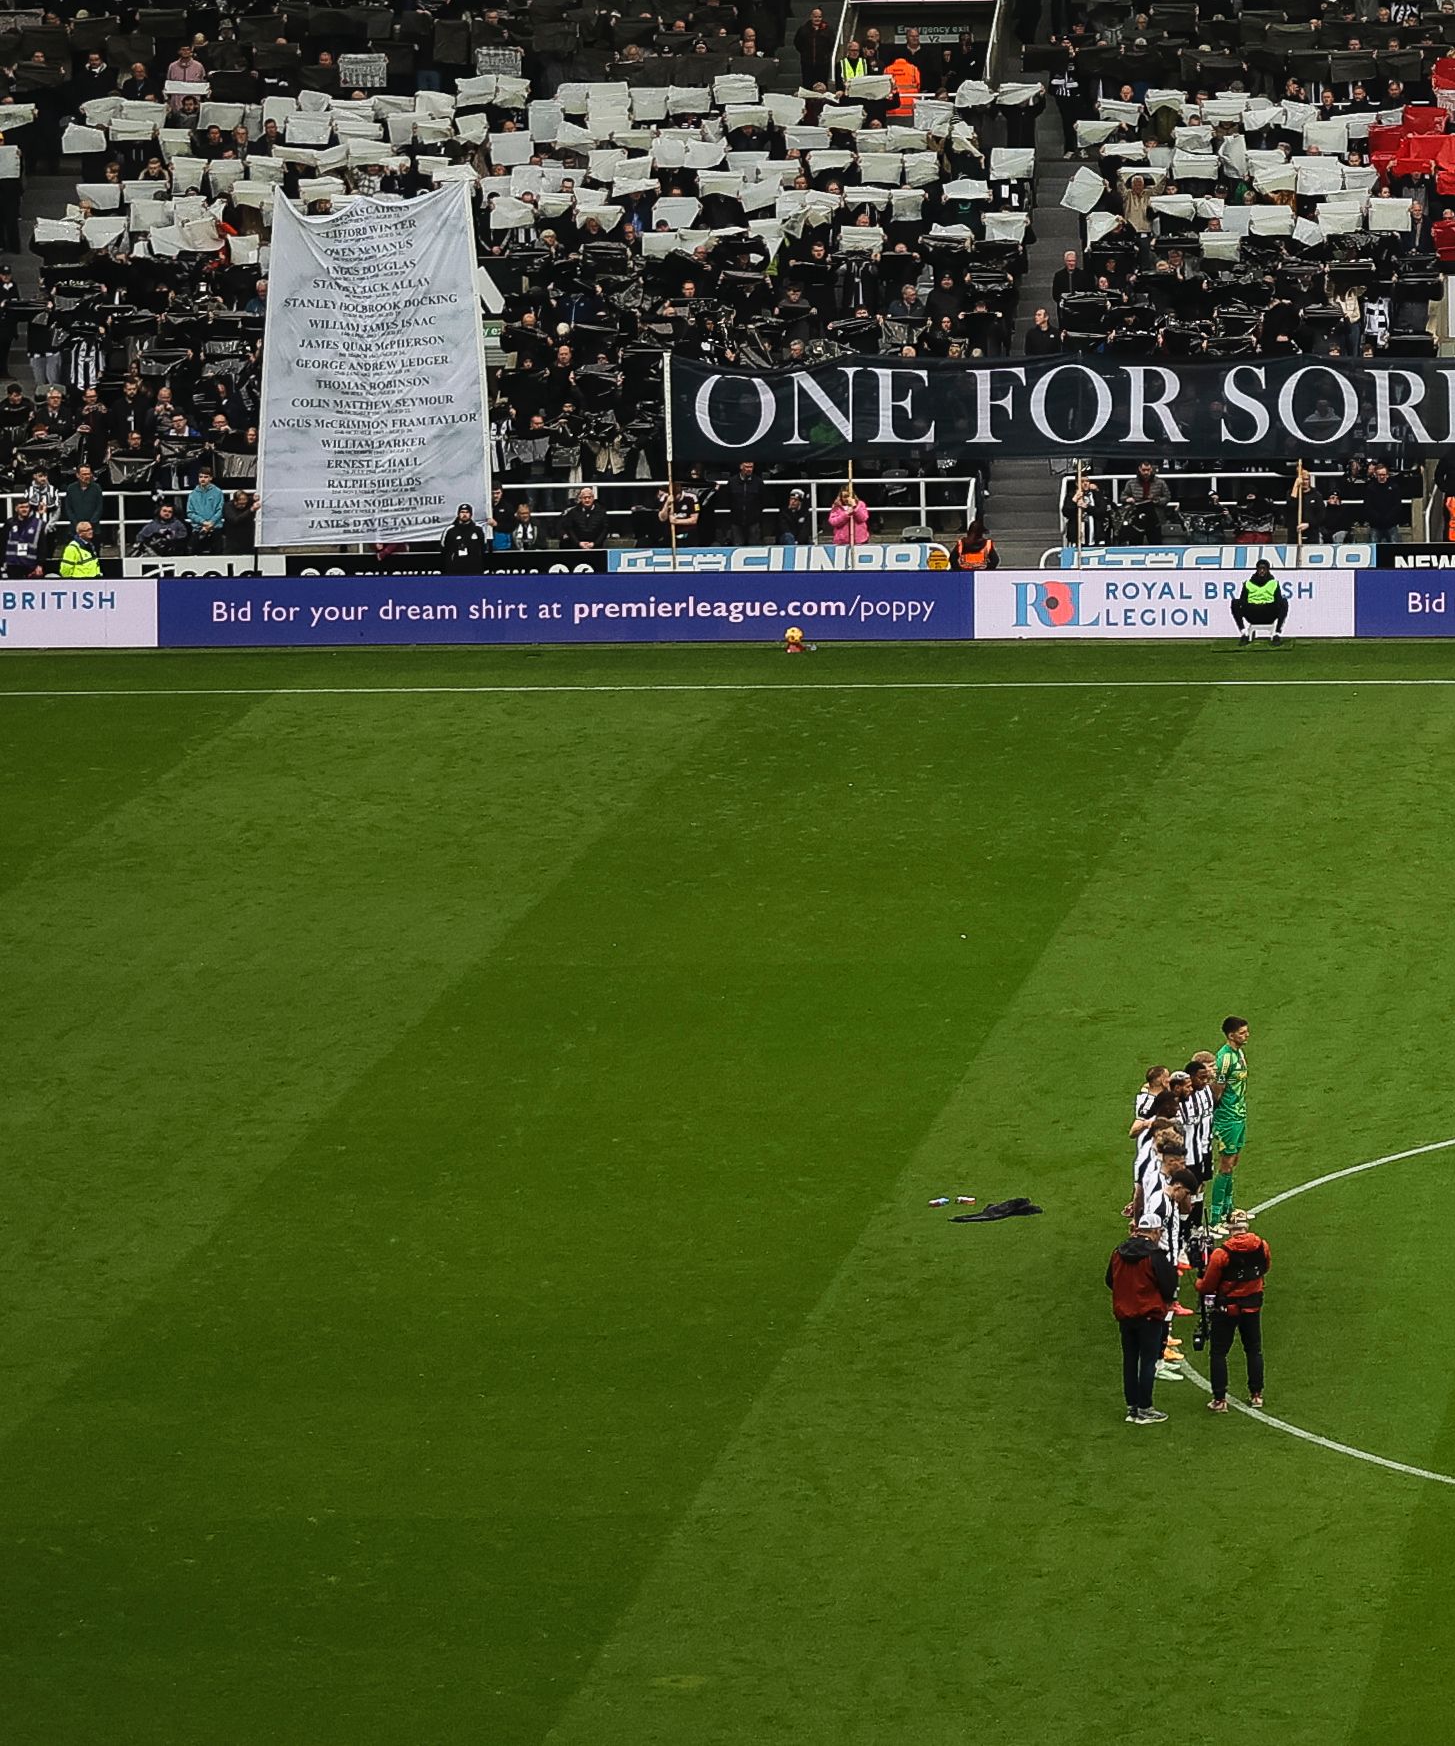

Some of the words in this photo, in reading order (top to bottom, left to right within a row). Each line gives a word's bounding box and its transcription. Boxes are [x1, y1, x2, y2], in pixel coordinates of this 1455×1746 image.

[369, 219, 416, 235] WINTER
[363, 259, 416, 274] DOUGLAS
[284, 297, 336, 310] STANLEY
[340, 300, 400, 313] HOLBROOK
[404, 294, 457, 309] DOCKING
[309, 319, 359, 333] WILLIAM
[363, 320, 399, 333] JAMES
[402, 316, 437, 328] ISAAC
[299, 338, 339, 350] JAMES
[296, 359, 346, 370] GEORGE
[349, 360, 398, 372] ANDREW
[401, 355, 449, 367] LEDGER
[316, 379, 366, 391] THOMAS
[369, 376, 430, 390] ROBINSON
[291, 398, 330, 408] COLIN
[333, 399, 390, 411] MATTHEW
[395, 395, 454, 409] SEYMOUR
[695, 364, 936, 450] ONE
[989, 365, 1191, 446] FOR
[270, 418, 312, 429] ANGUS
[392, 416, 427, 428] FRAM
[429, 413, 477, 426] TAYLOR
[321, 439, 374, 449] WILLIAM
[377, 437, 427, 449] PARKER
[327, 459, 371, 469] ERNEST
[388, 457, 422, 468] HALL
[327, 478, 368, 489] RALPH
[370, 477, 422, 489] SHIELDS
[303, 499, 361, 510] WILLIAM
[364, 498, 405, 509] NOBLE
[408, 495, 446, 506] IMRIE
[308, 518, 350, 529] JAMES
[353, 517, 389, 528] DAVIS
[392, 515, 441, 527] TAYLOR
[1105, 582, 1186, 601] ROYAL
[1204, 581, 1314, 600] BRSH
[2, 591, 116, 611] BRITISH
[1408, 591, 1445, 614] Bid
[212, 601, 252, 624] Bid
[263, 600, 300, 623] for
[310, 605, 368, 629] your
[379, 599, 457, 621] dream
[468, 599, 529, 620] shirt
[538, 601, 562, 620] at
[574, 594, 935, 623] premierleague.com/poppy
[1105, 608, 1209, 626] LEGION
